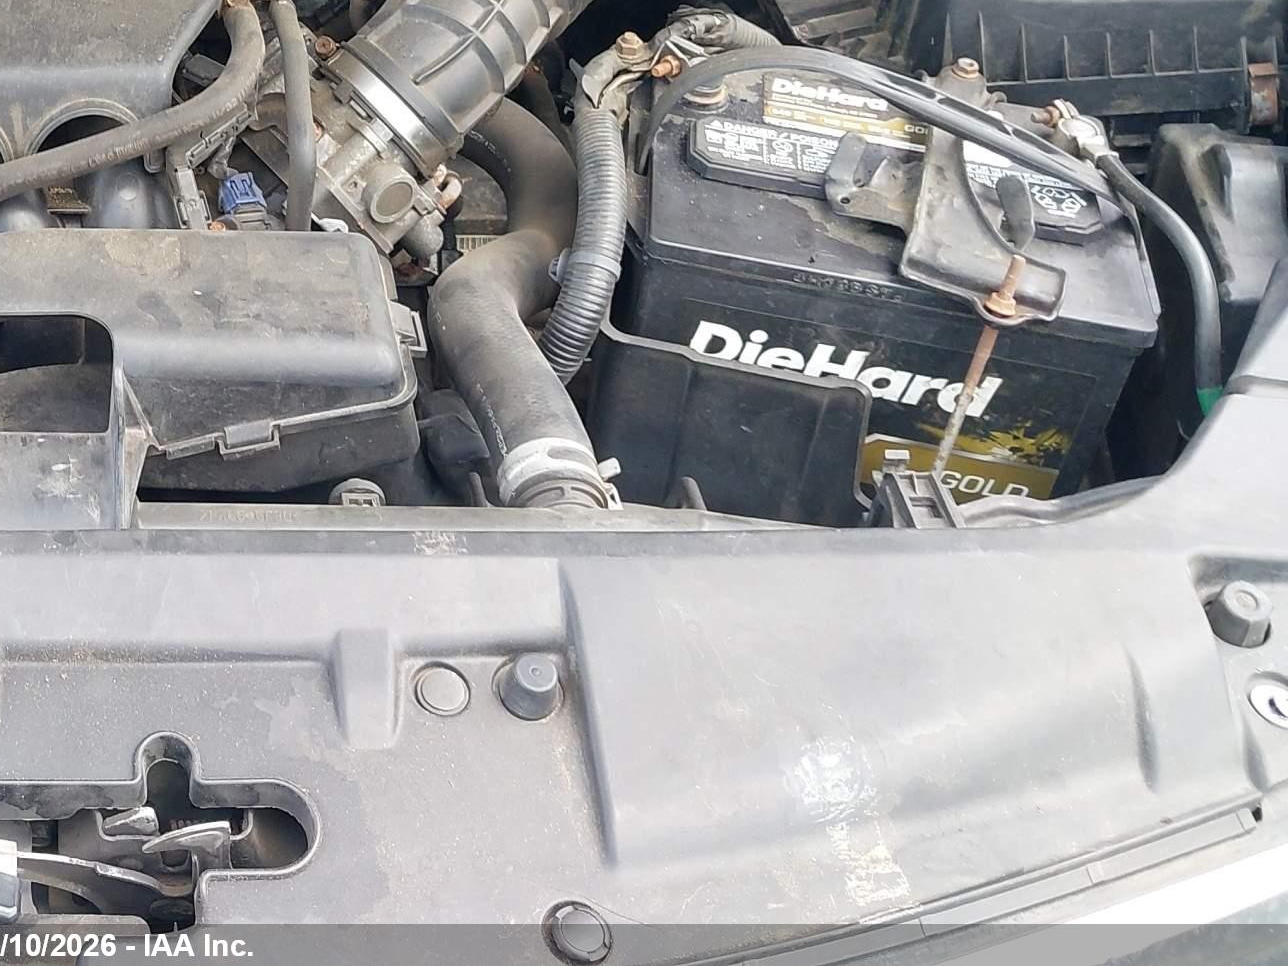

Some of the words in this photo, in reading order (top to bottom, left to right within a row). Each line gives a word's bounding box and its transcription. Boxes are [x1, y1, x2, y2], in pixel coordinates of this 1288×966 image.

[771, 77, 889, 112] DieHard
[723, 121, 778, 140] DANGER
[790, 133, 840, 149] POISON
[688, 320, 1004, 418] DieHard
[940, 469, 1029, 497] GOLD
